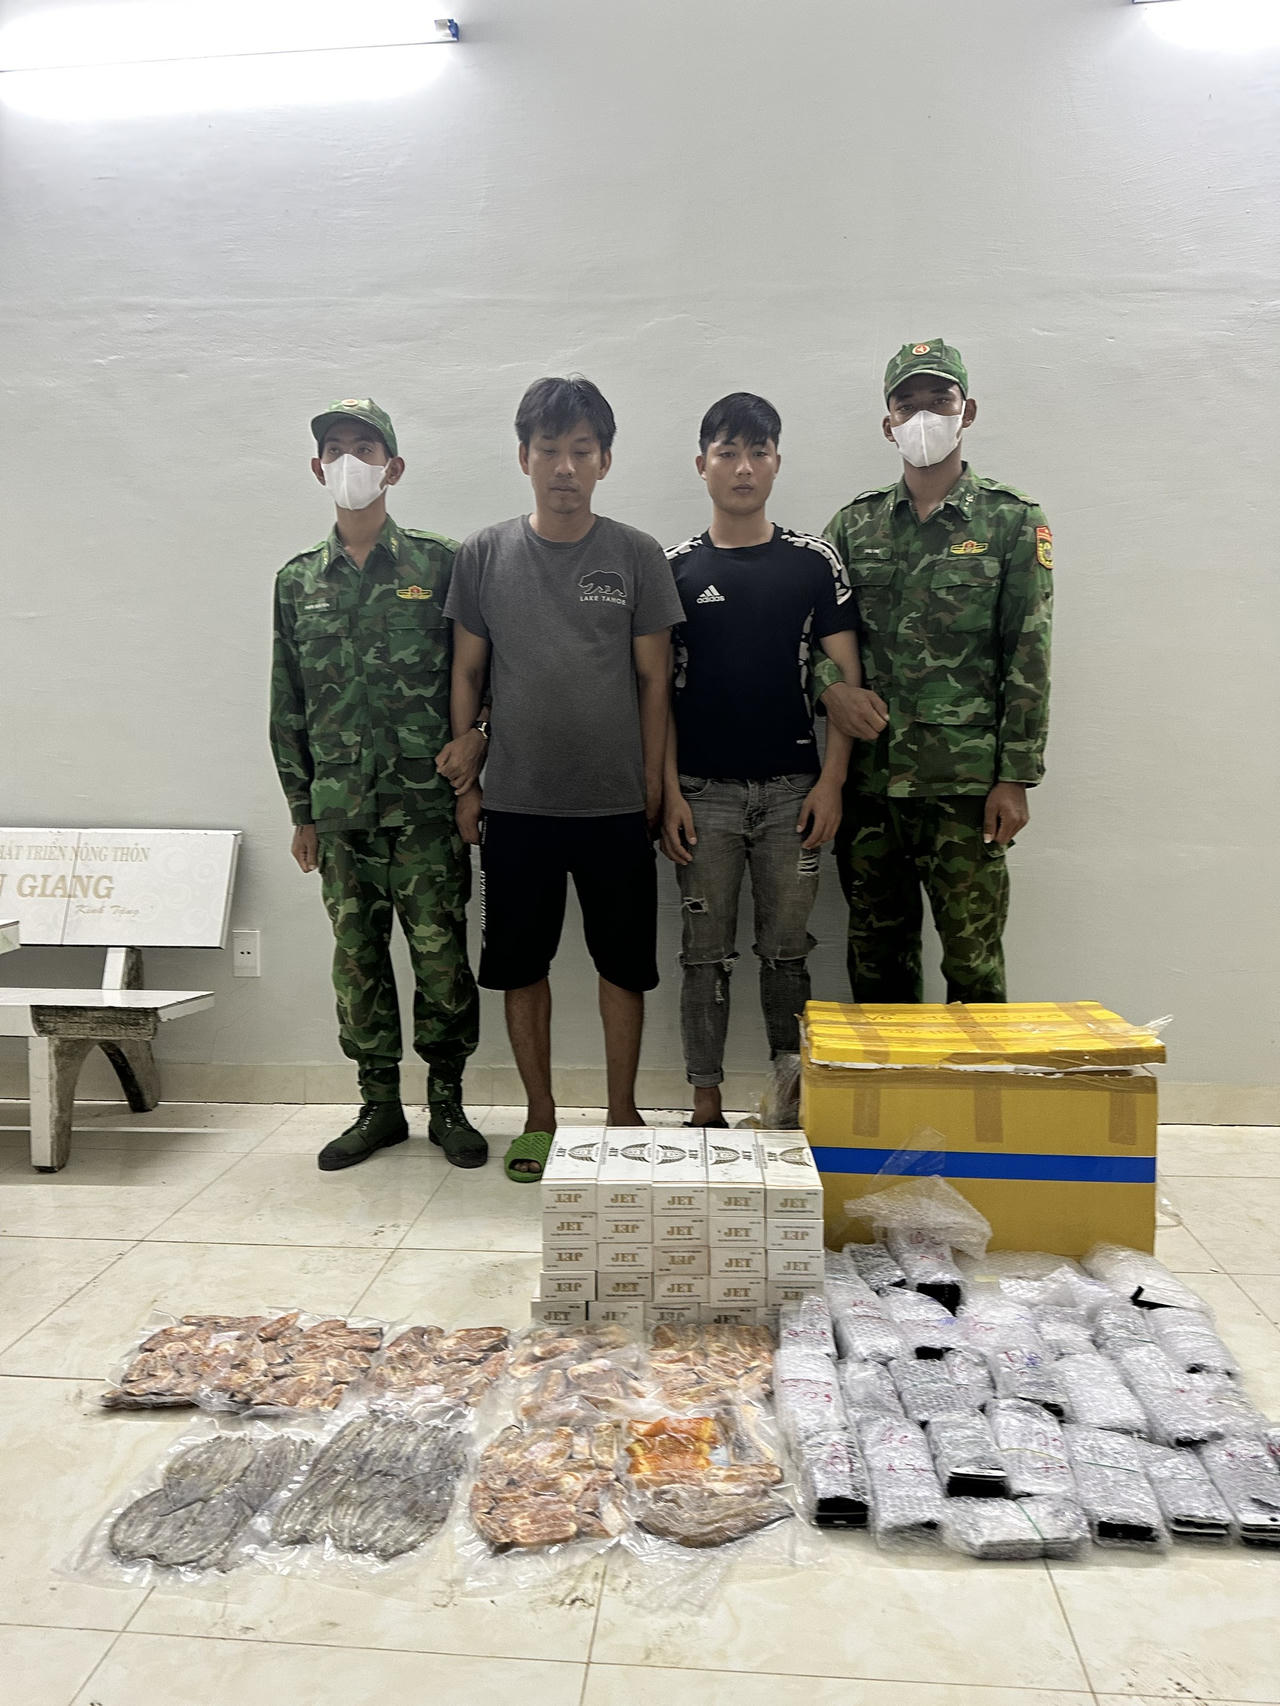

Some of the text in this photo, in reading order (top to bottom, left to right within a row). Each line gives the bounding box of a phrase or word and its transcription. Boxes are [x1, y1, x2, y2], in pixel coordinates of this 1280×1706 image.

[602, 595, 627, 606] TAHOE
[696, 595, 726, 604] adidas
[70, 842, 109, 862] NÔNG
[112, 842, 151, 863] THÔN
[16, 873, 115, 899] GIANG
[555, 1193, 582, 1203] JET
[610, 1193, 638, 1203] JET
[667, 1195, 695, 1205] JET
[723, 1196, 752, 1207] JET
[780, 1198, 808, 1208] JET
[556, 1221, 584, 1231] JET
[611, 1224, 640, 1233] JET
[666, 1225, 694, 1236] JET
[724, 1227, 752, 1237] JET
[781, 1230, 809, 1240] JET
[555, 1252, 583, 1261] JET
[611, 1252, 639, 1262] JET
[668, 1255, 696, 1265] JET
[724, 1258, 753, 1268] JET
[783, 1261, 811, 1271] JET
[555, 1282, 582, 1292] JET
[611, 1282, 639, 1292] JET
[666, 1283, 694, 1293] JET
[723, 1287, 751, 1297] JET
[543, 1311, 571, 1321] JET
[713, 1314, 741, 1324] JET
